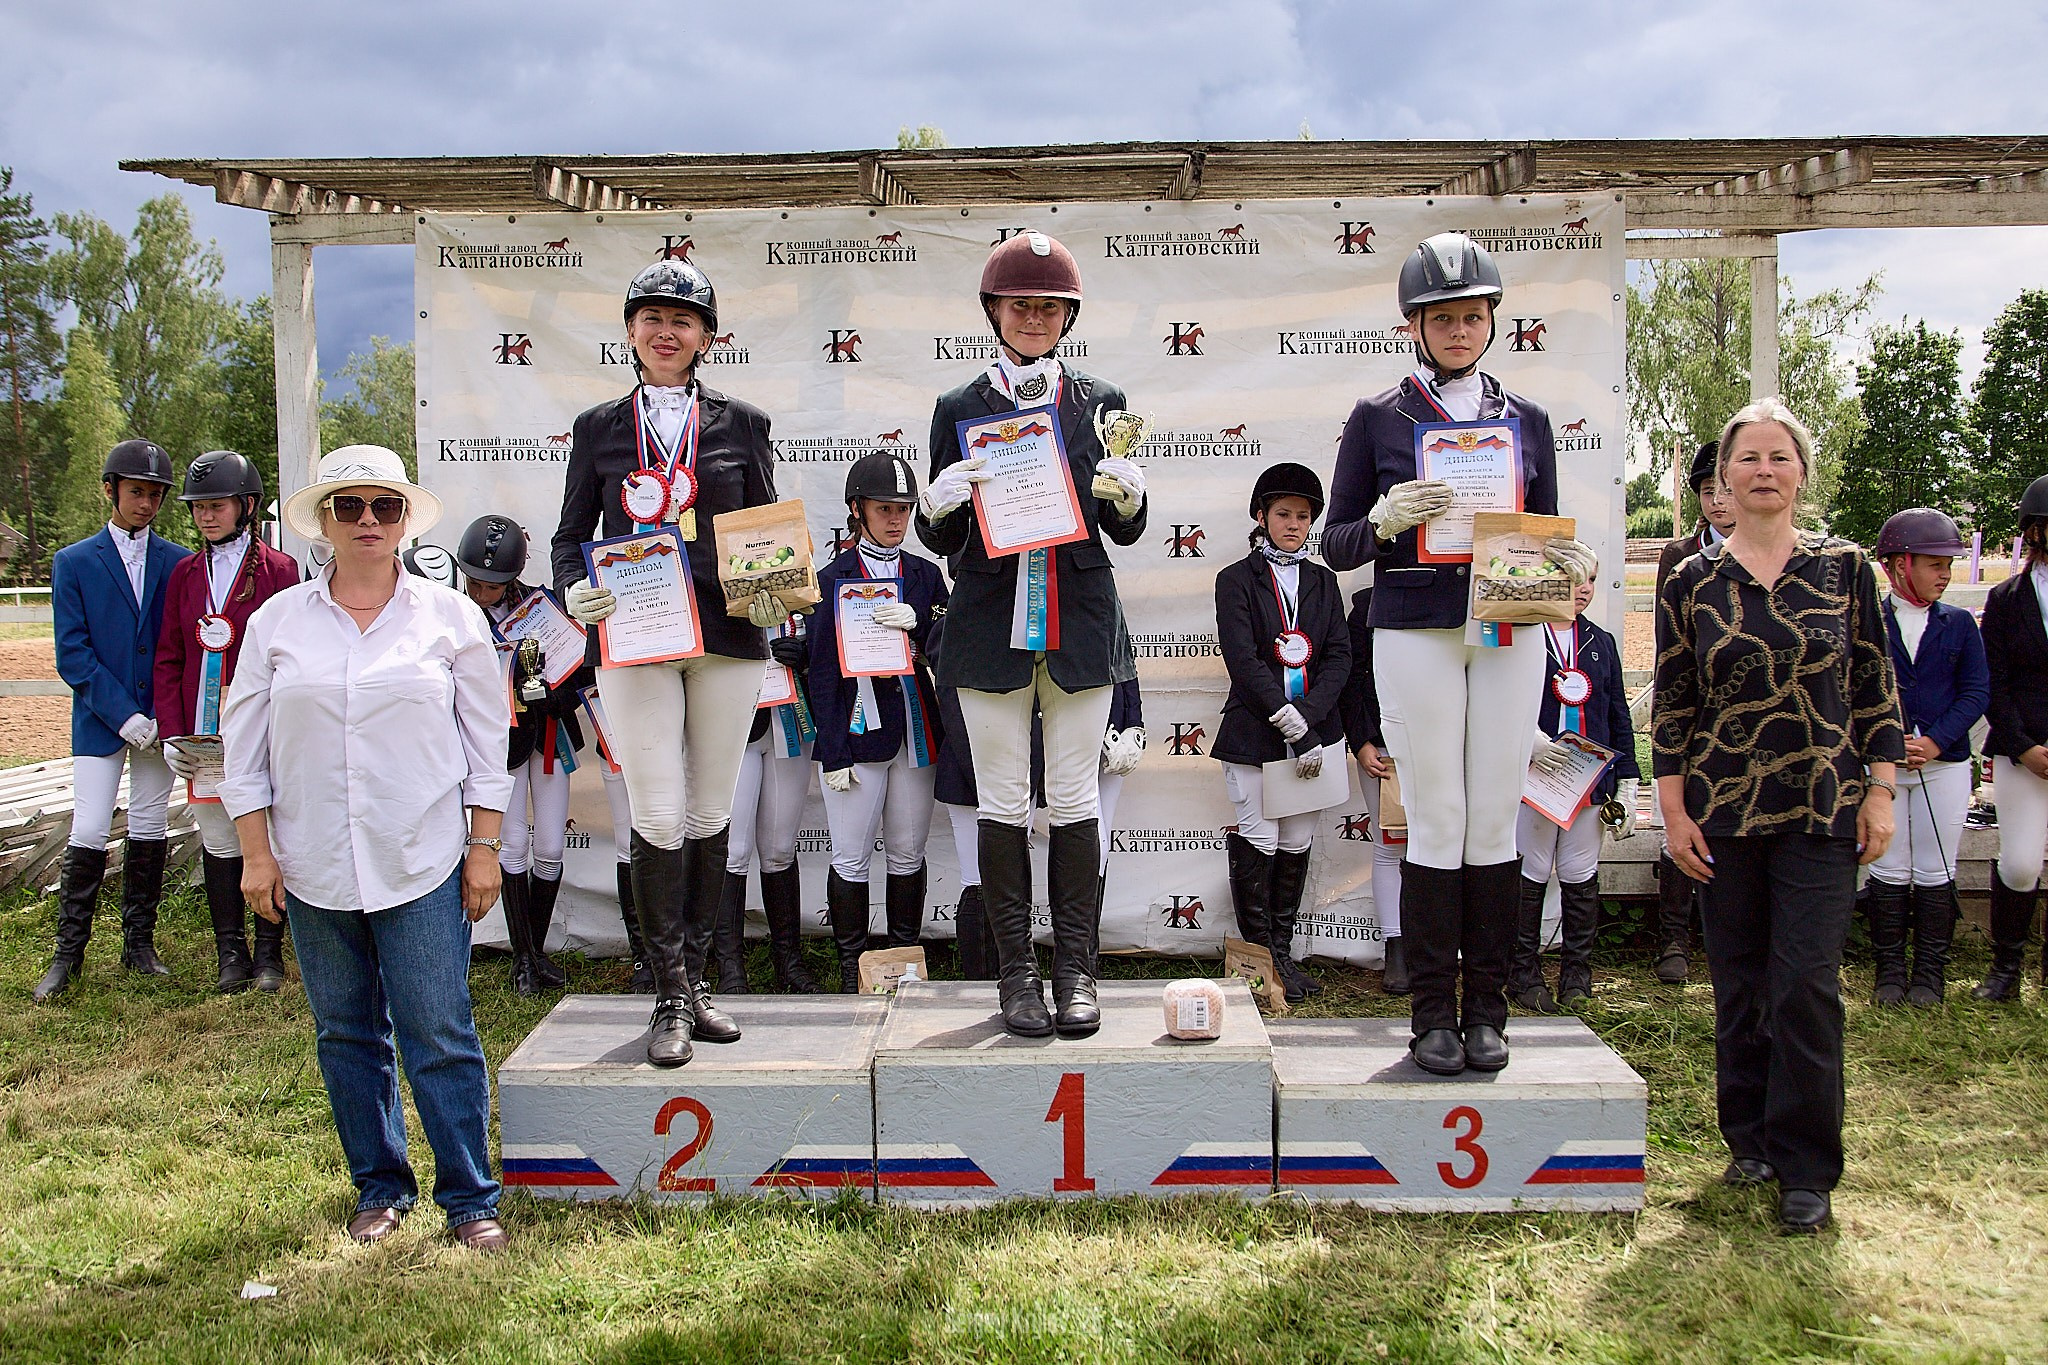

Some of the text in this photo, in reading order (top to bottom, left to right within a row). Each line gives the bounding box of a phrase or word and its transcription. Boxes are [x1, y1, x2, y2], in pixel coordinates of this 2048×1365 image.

[1125, 231, 1212, 243] конный завод
[1469, 226, 1556, 237] конный завод
[457, 243, 537, 254] конный завод
[786, 238, 870, 249] конный завод
[1104, 235, 1260, 258] Калгановский
[1449, 230, 1603, 253] лгановский
[438, 246, 583, 269] Калгановский
[765, 242, 917, 265] Калгановский
[1298, 328, 1385, 340] конный завод
[1277, 332, 1417, 355] Калгановски
[459, 436, 540, 447] конный завод
[787, 436, 871, 447] конный завод
[1178, 432, 1214, 442] завод
[438, 439, 572, 462] Калгановски
[990, 442, 1038, 460] ДИПЛОМ
[1130, 440, 1262, 458] алгановский
[1444, 454, 1494, 465] ДИПЛОМ
[616, 561, 663, 579] ДИПЛОМ
[1179, 633, 1214, 643] завод
[1108, 830, 1230, 853] Калгановс
[1128, 828, 1214, 839] конный завод
[1340, 915, 1374, 927] завод
[1294, 921, 1382, 942] алгановс
[1044, 1072, 1096, 1192] 1
[653, 1096, 716, 1192] 2
[1436, 1105, 1490, 1189] 3
